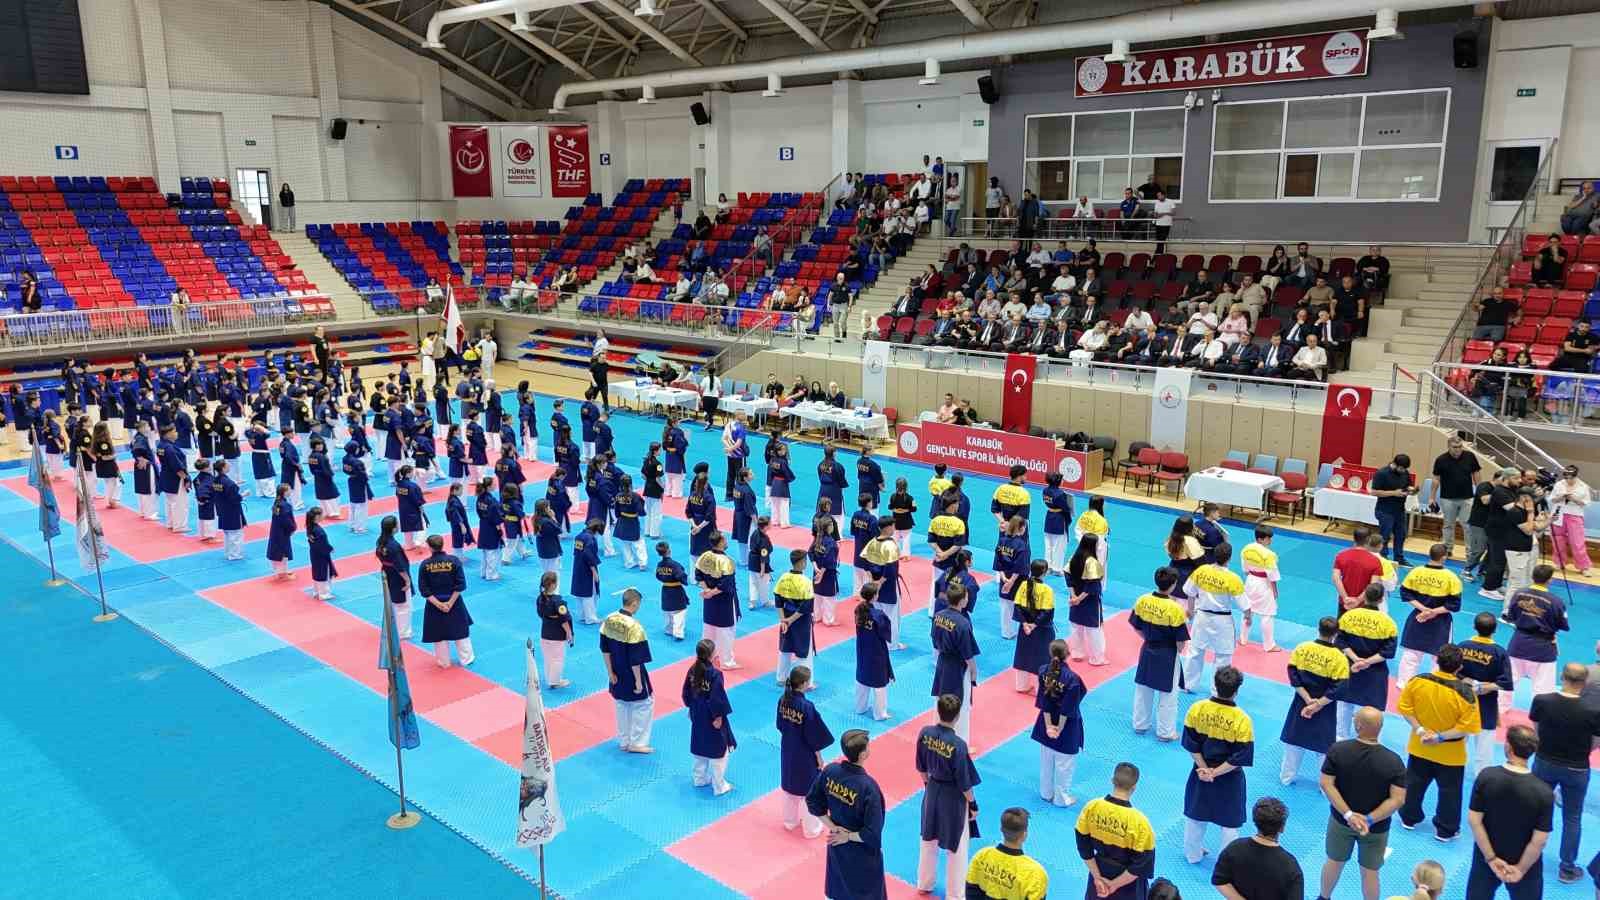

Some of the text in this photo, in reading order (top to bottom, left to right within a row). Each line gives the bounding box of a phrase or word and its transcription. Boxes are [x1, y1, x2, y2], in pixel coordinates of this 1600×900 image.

[1121, 42, 1306, 86] KARABÜK
[61, 147, 75, 159] D
[783, 148, 792, 160] B
[557, 169, 585, 181] THF
[966, 436, 1003, 451] KARABÜK
[926, 444, 956, 458] GENÇLİK
[957, 449, 967, 459] VE
[968, 451, 988, 463] SPOR
